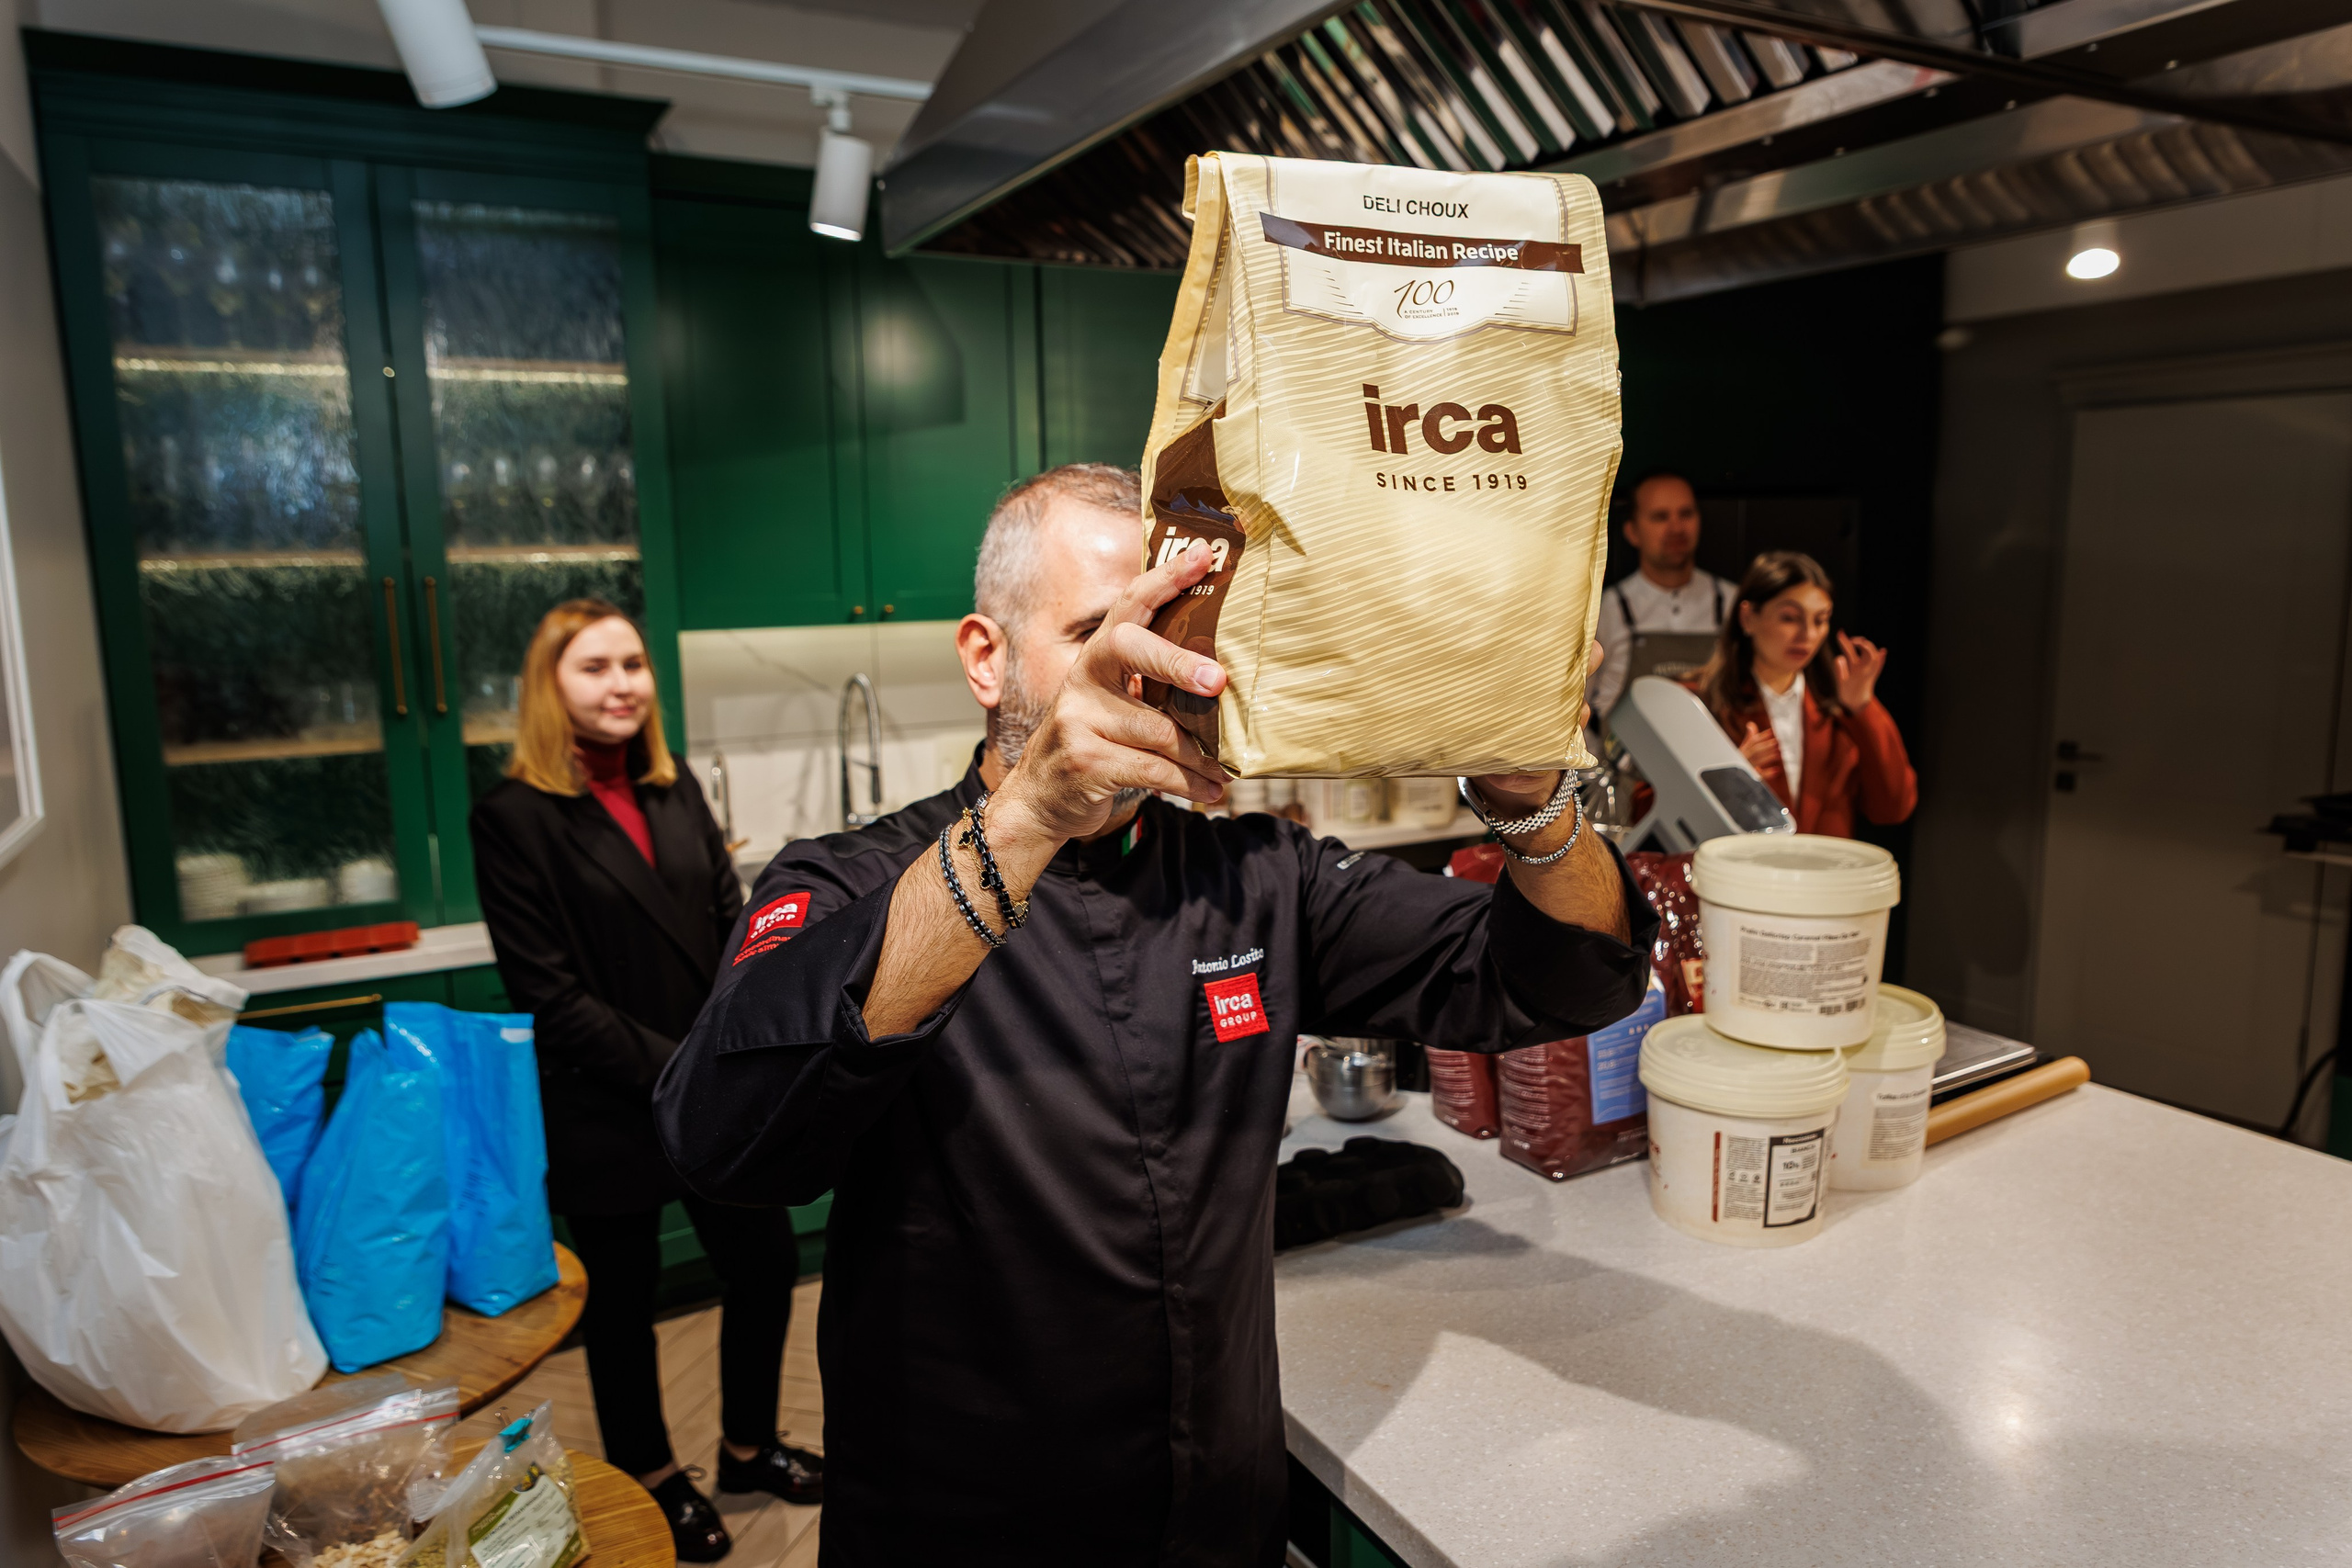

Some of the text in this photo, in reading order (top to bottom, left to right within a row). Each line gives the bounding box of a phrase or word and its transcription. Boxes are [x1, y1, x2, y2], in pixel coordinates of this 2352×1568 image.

[1363, 195, 1469, 219] DELI CHOUX
[1323, 231, 1519, 263] Finest Italian Recipe
[1394, 279, 1454, 318] 100
[1363, 383, 1522, 455] irca
[1376, 472, 1529, 492] SINCE 1919
[1190, 584, 1215, 596] 1919
[1214, 993, 1254, 1015] irca
[1219, 1010, 1258, 1028] GROUP
